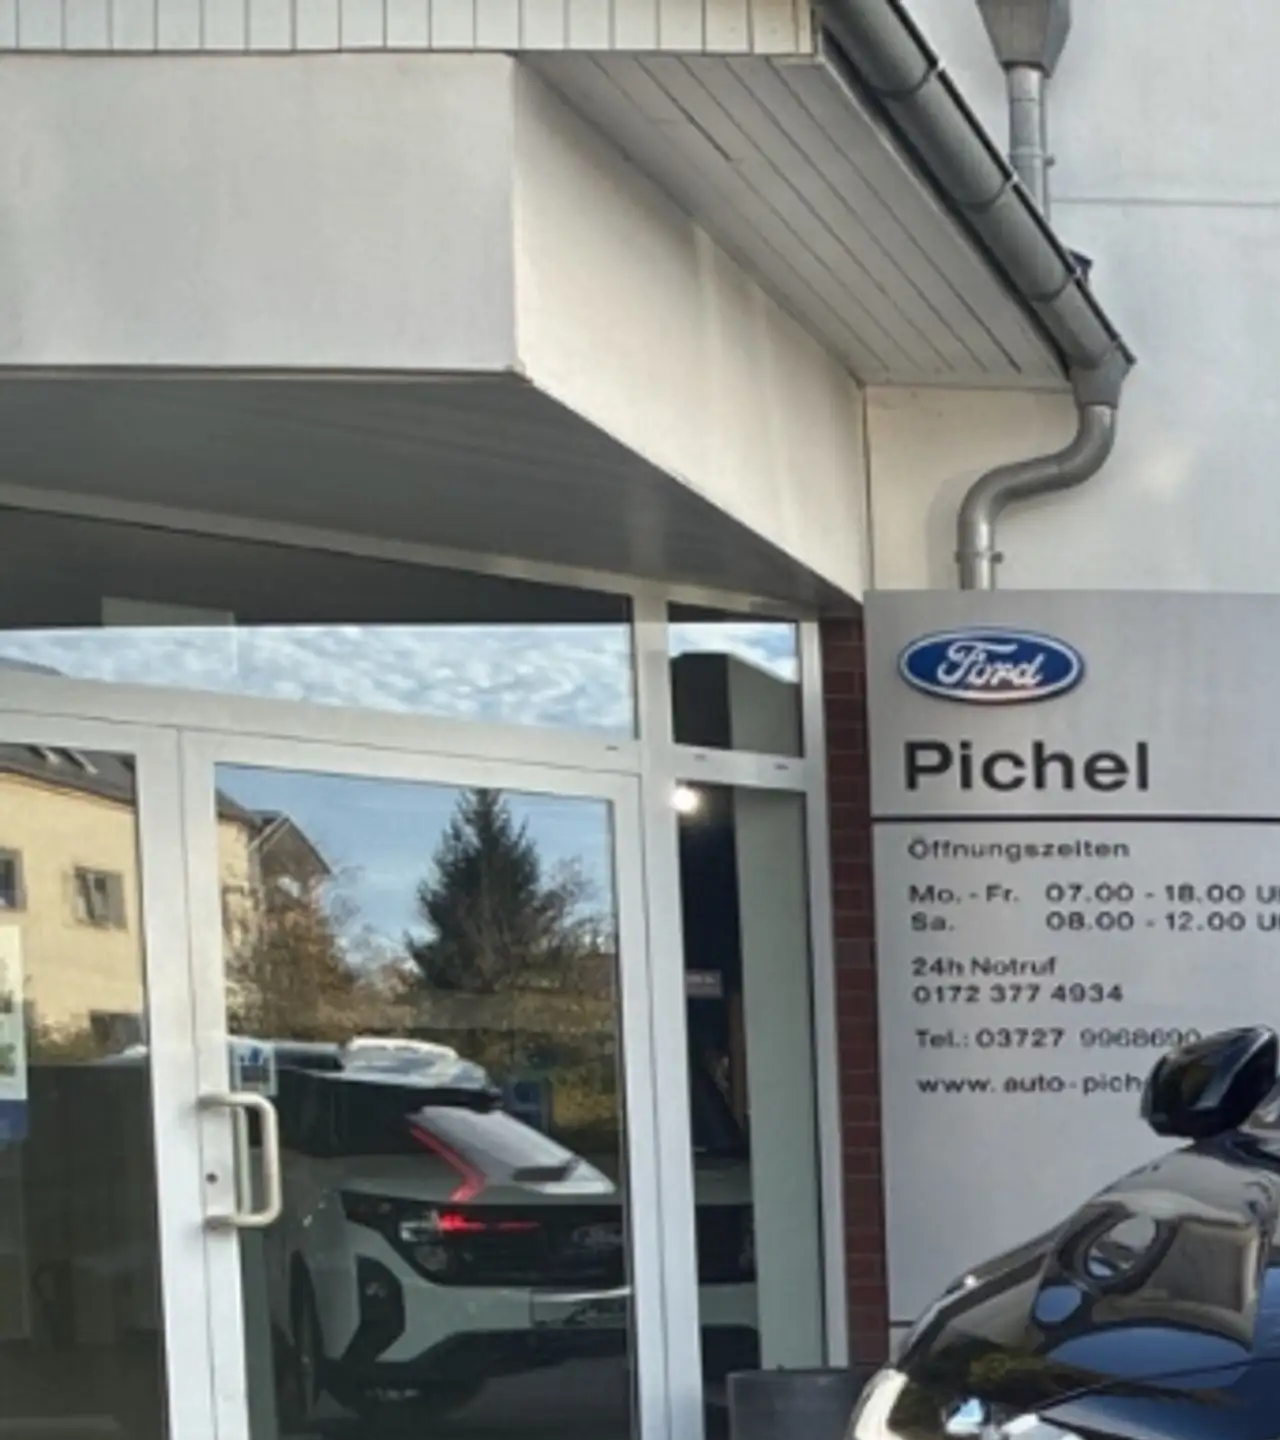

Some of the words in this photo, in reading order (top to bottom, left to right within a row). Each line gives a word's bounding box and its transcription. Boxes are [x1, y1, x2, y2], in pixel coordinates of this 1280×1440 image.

[936, 640, 1044, 687] Ford
[904, 740, 1150, 791] Pichel
[907, 837, 1130, 863] Öffnungszeiten
[1045, 883, 1134, 903] 07.00
[1165, 884, 1246, 903] 18.00
[911, 912, 956, 932] Sa.
[1045, 911, 1135, 931] 08.00
[1165, 911, 1246, 931] 12.00
[911, 956, 965, 977] 24h
[970, 956, 1057, 976] Notruf
[911, 983, 981, 1004] 0172
[989, 983, 1041, 1003] 377
[1050, 982, 1124, 1003] 4934
[915, 1029, 969, 1048] Tel.:
[975, 1028, 1065, 1048] 03727
